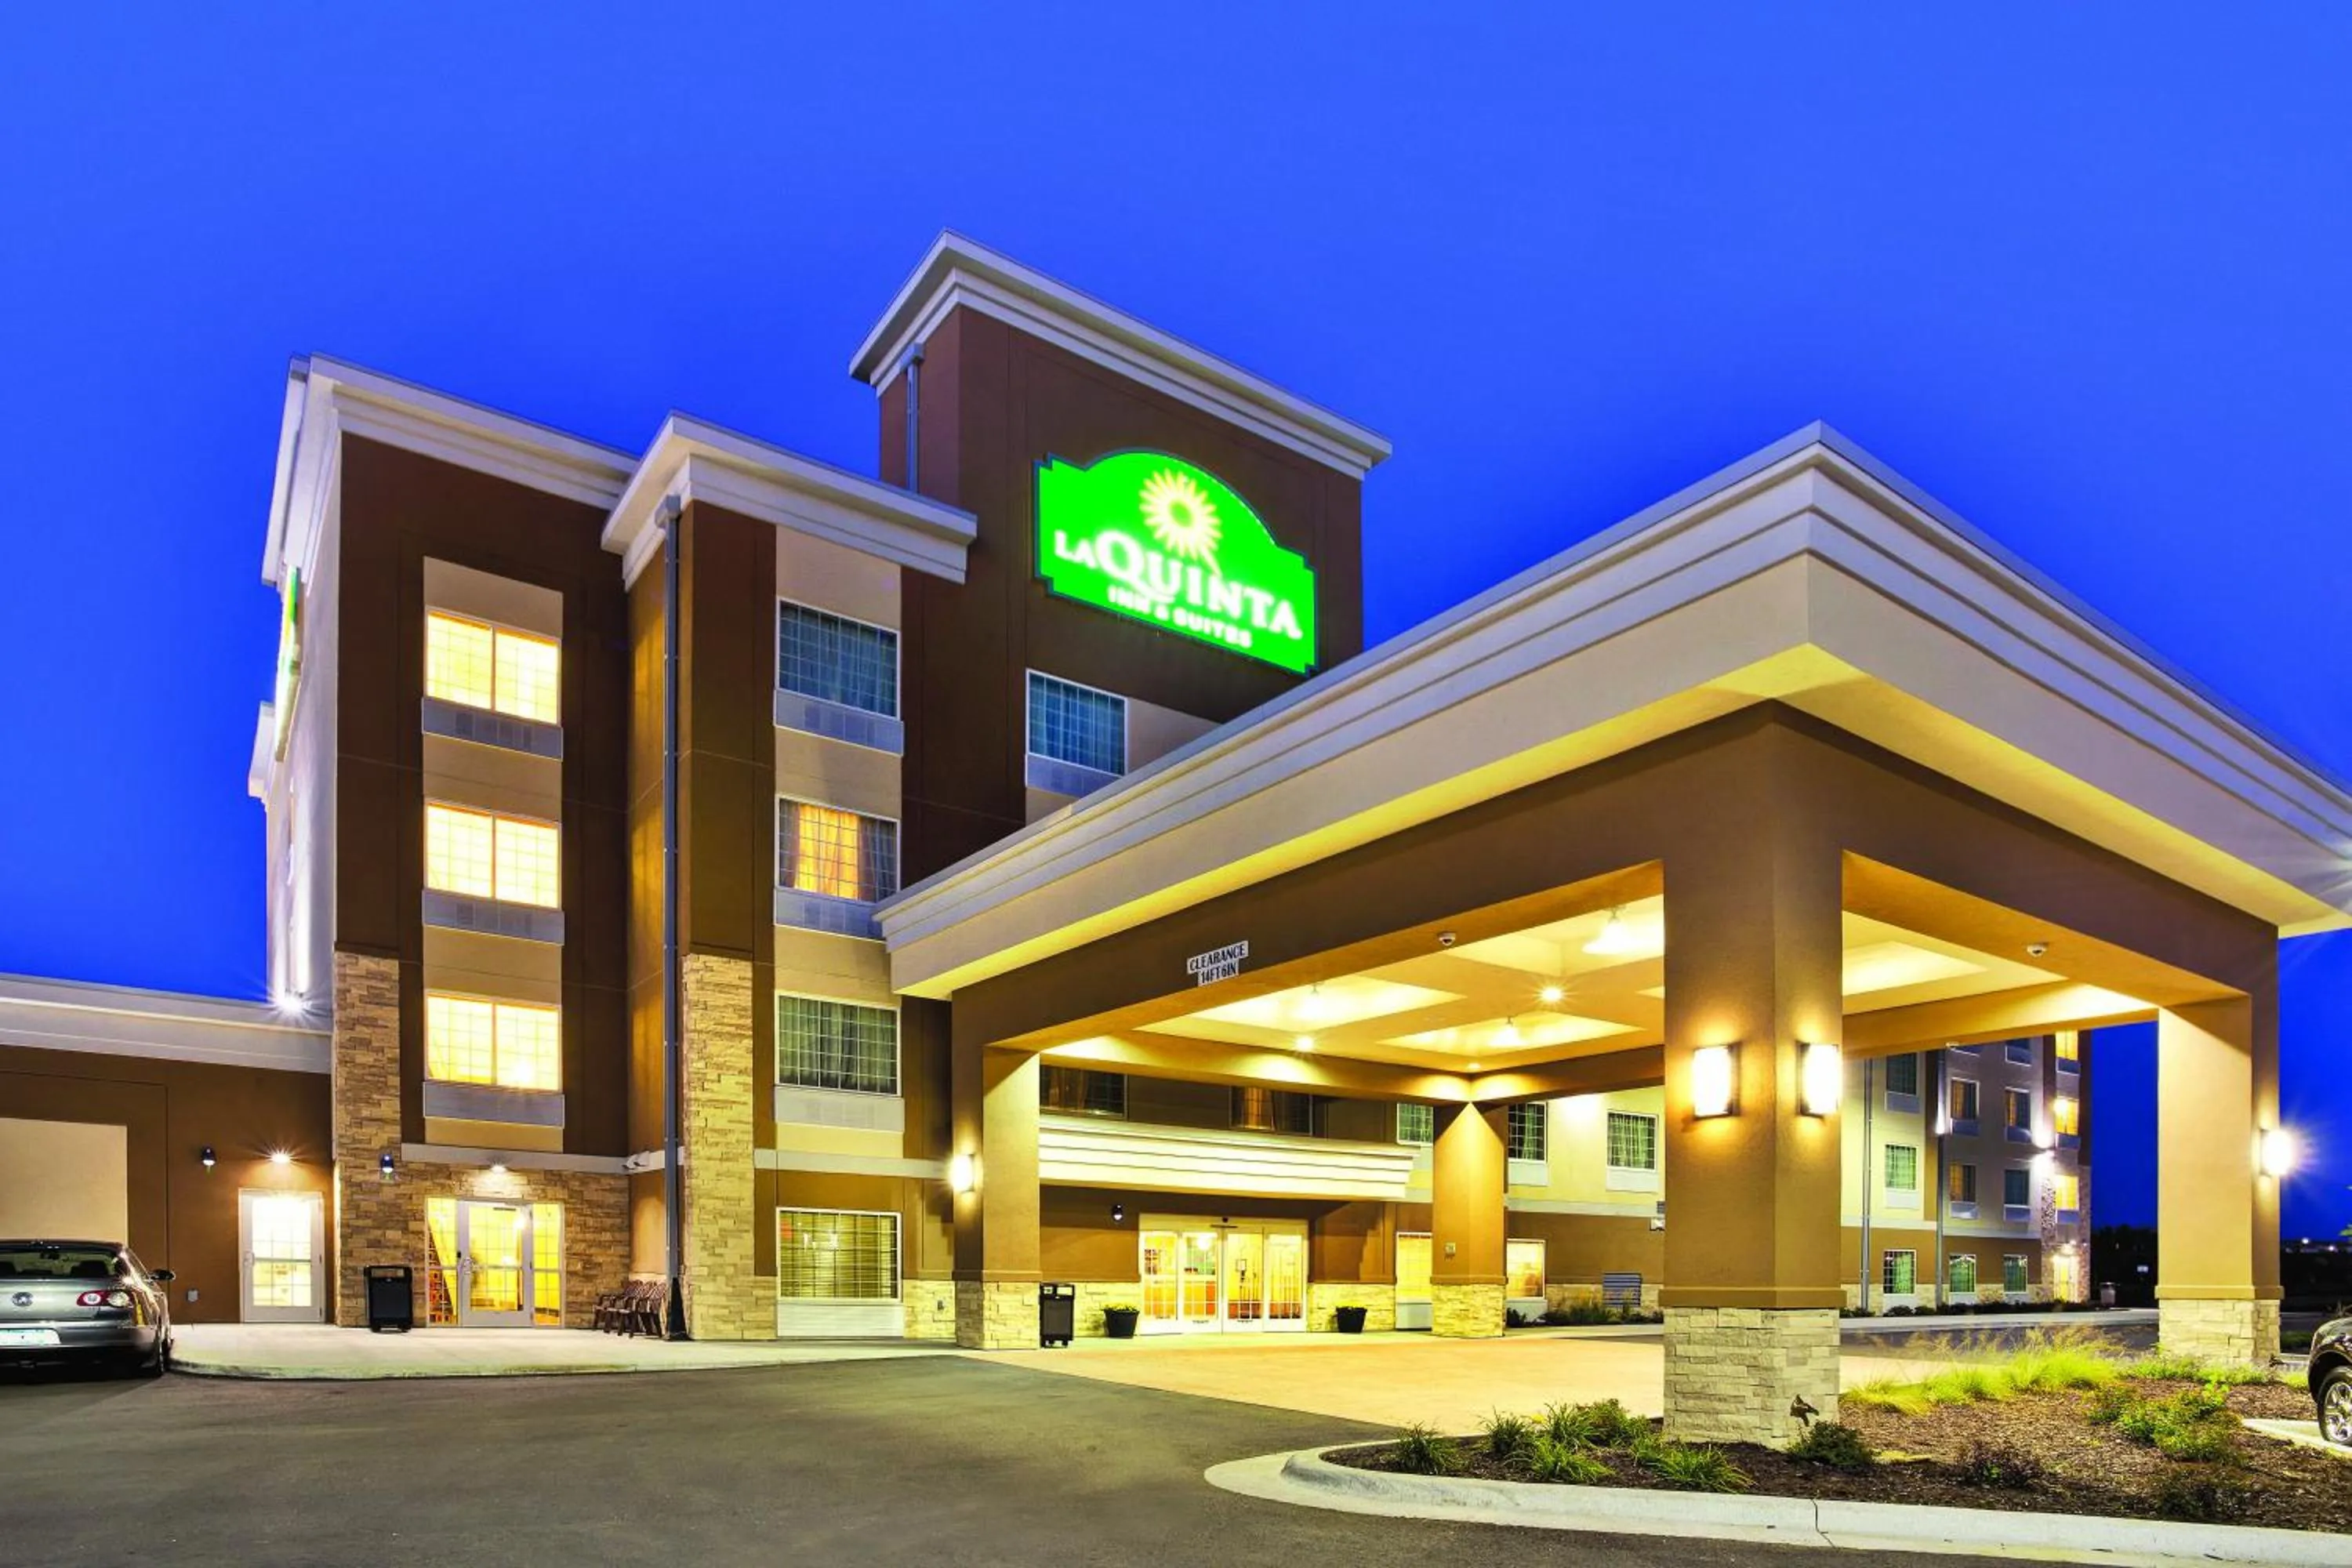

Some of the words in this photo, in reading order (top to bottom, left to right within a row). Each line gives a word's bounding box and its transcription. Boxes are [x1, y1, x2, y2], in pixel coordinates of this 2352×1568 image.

[1054, 530, 1096, 568] LA
[1094, 529, 1303, 640] QUINTA
[1190, 943, 1246, 971] CLEARANCE
